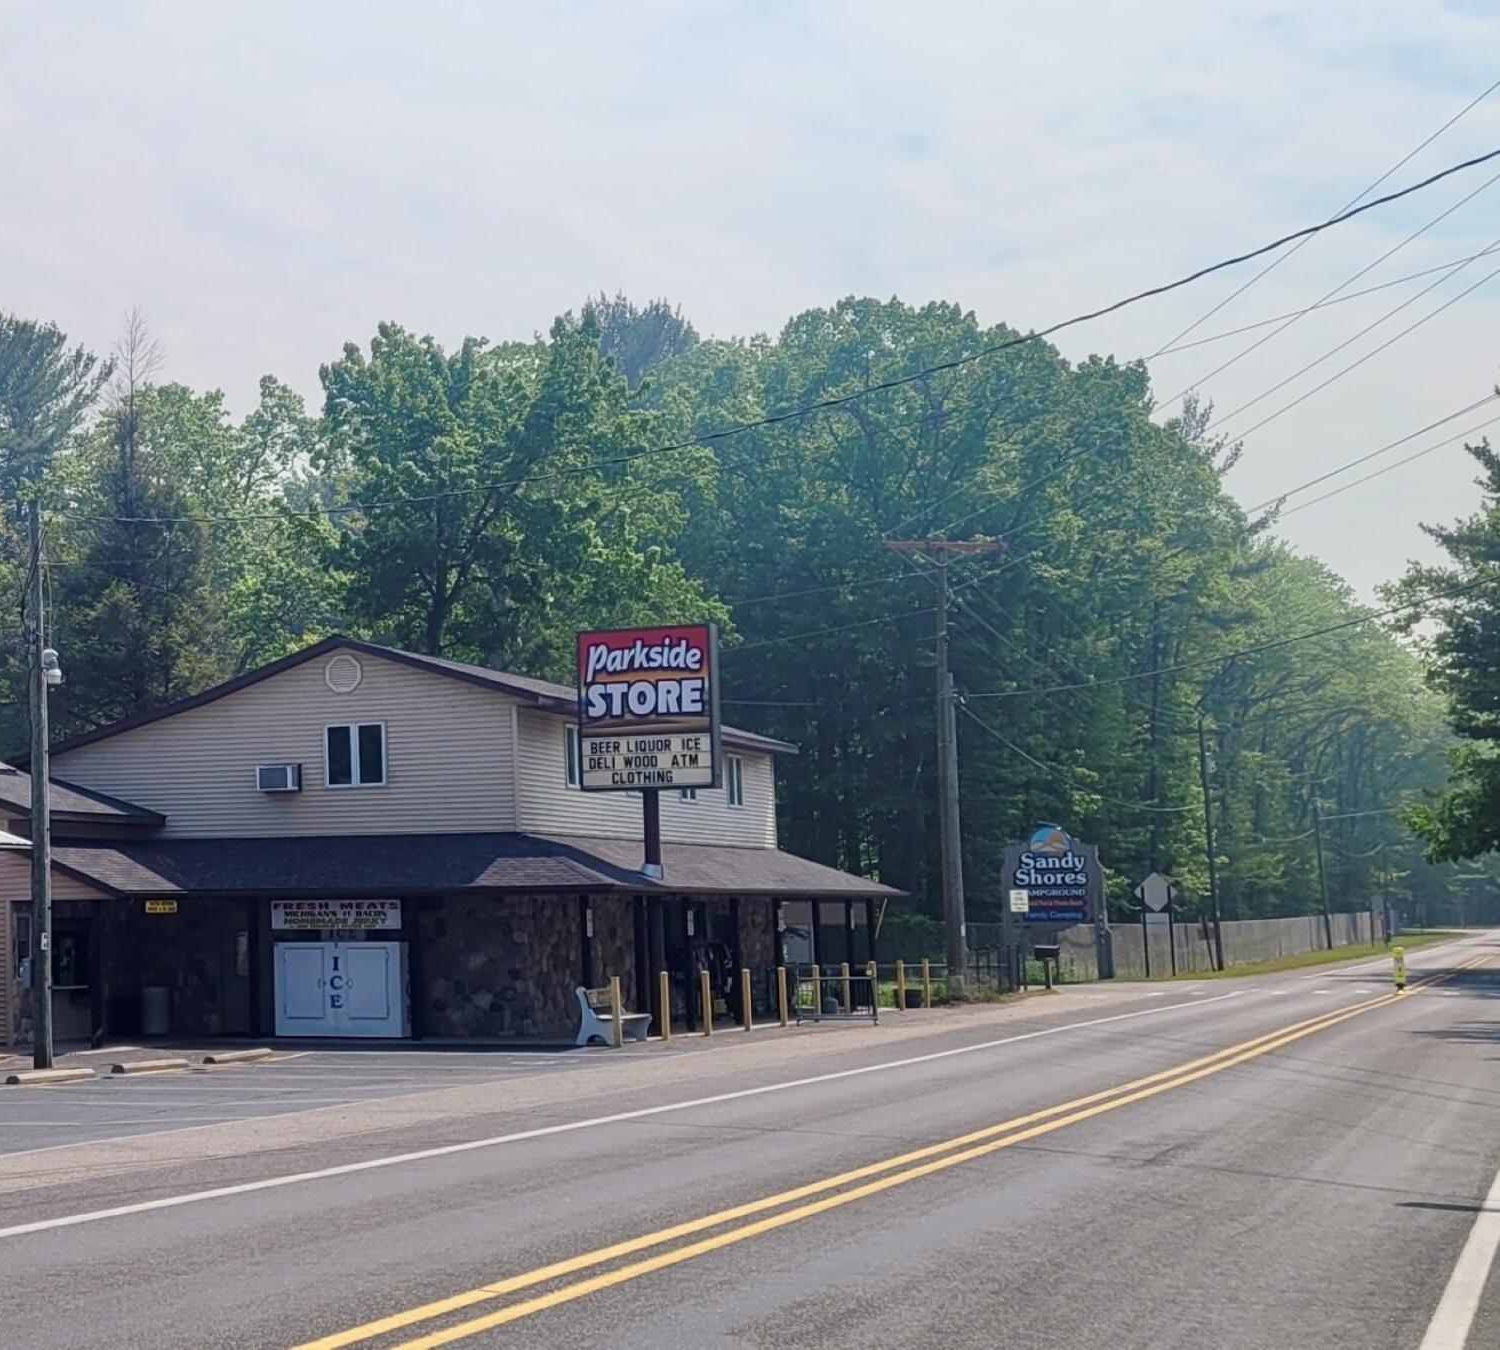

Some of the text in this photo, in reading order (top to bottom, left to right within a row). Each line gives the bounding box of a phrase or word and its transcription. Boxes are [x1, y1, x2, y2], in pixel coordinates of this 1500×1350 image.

[587, 638, 701, 682] Parkside
[587, 680, 703, 717] STORE
[591, 738, 701, 754] BEER LIQUOR ICE
[589, 754, 699, 770] DELI WOOD ATM
[612, 771, 673, 784] CLOTHING
[1021, 852, 1084, 871] Sandy
[1015, 868, 1087, 885] Shores
[273, 901, 399, 911] FRESH MEATS
[329, 956, 344, 1009] ICE
